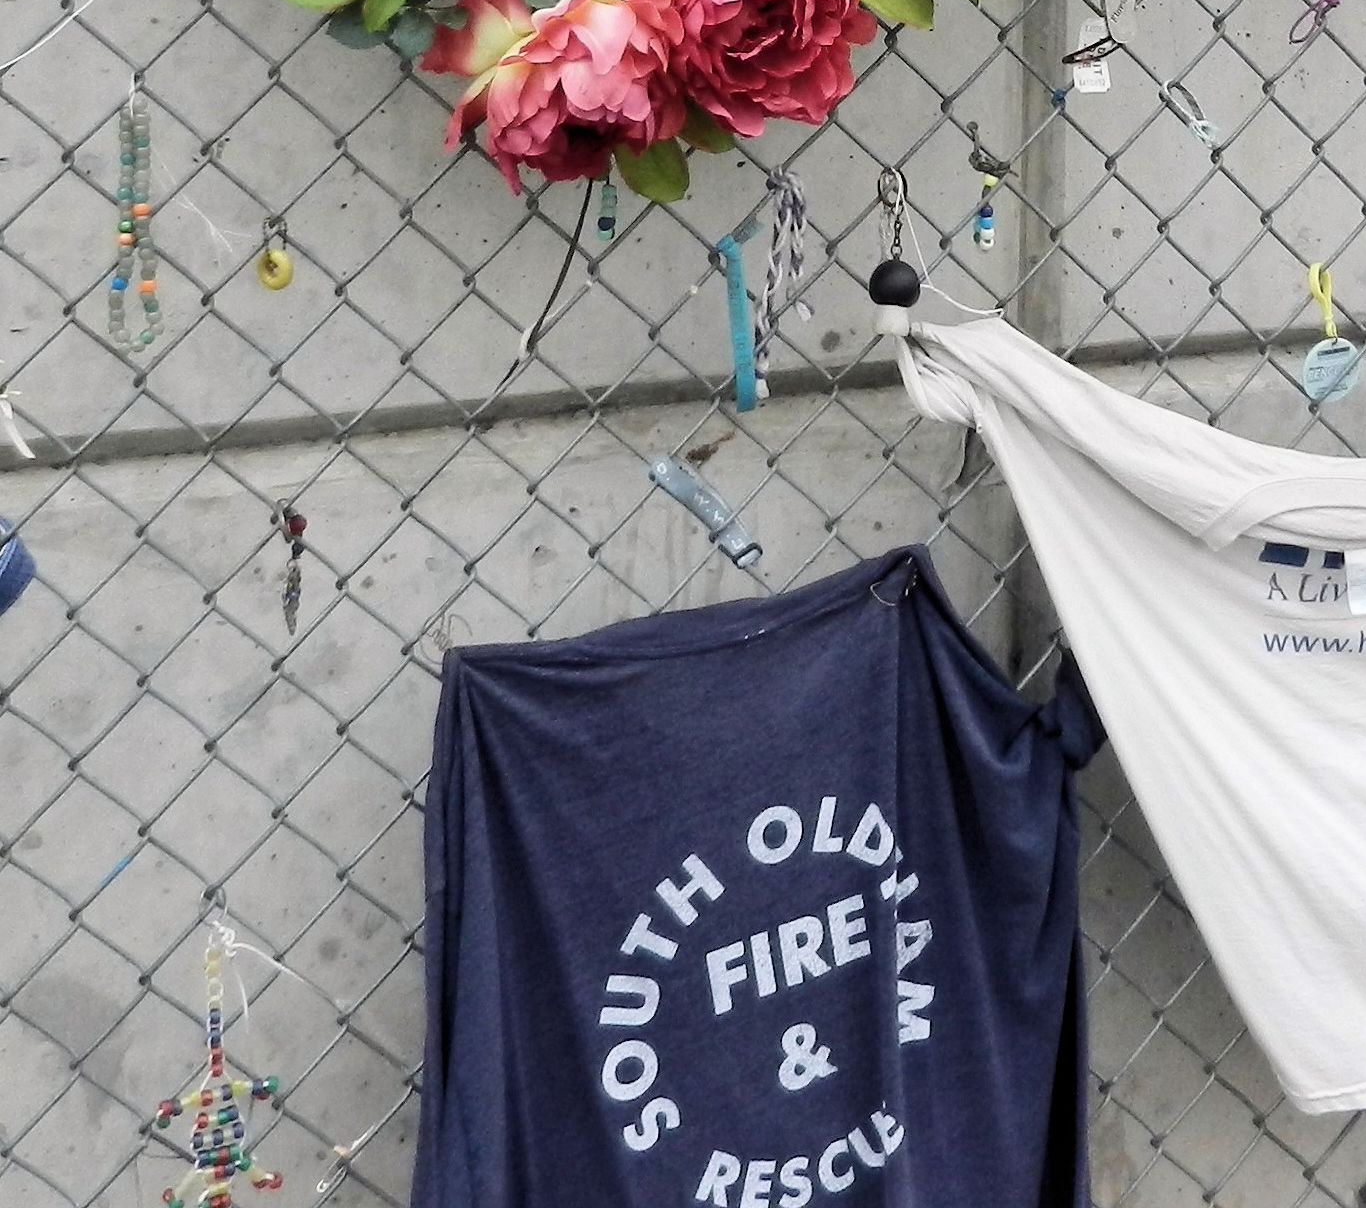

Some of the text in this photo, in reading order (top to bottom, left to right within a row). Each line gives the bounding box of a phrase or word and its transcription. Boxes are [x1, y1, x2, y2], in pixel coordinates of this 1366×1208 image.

[1267, 572, 1288, 600] A
[598, 852, 726, 1152] SOUTH
[705, 893, 872, 1016] FIRE
[777, 1022, 838, 1091] &
